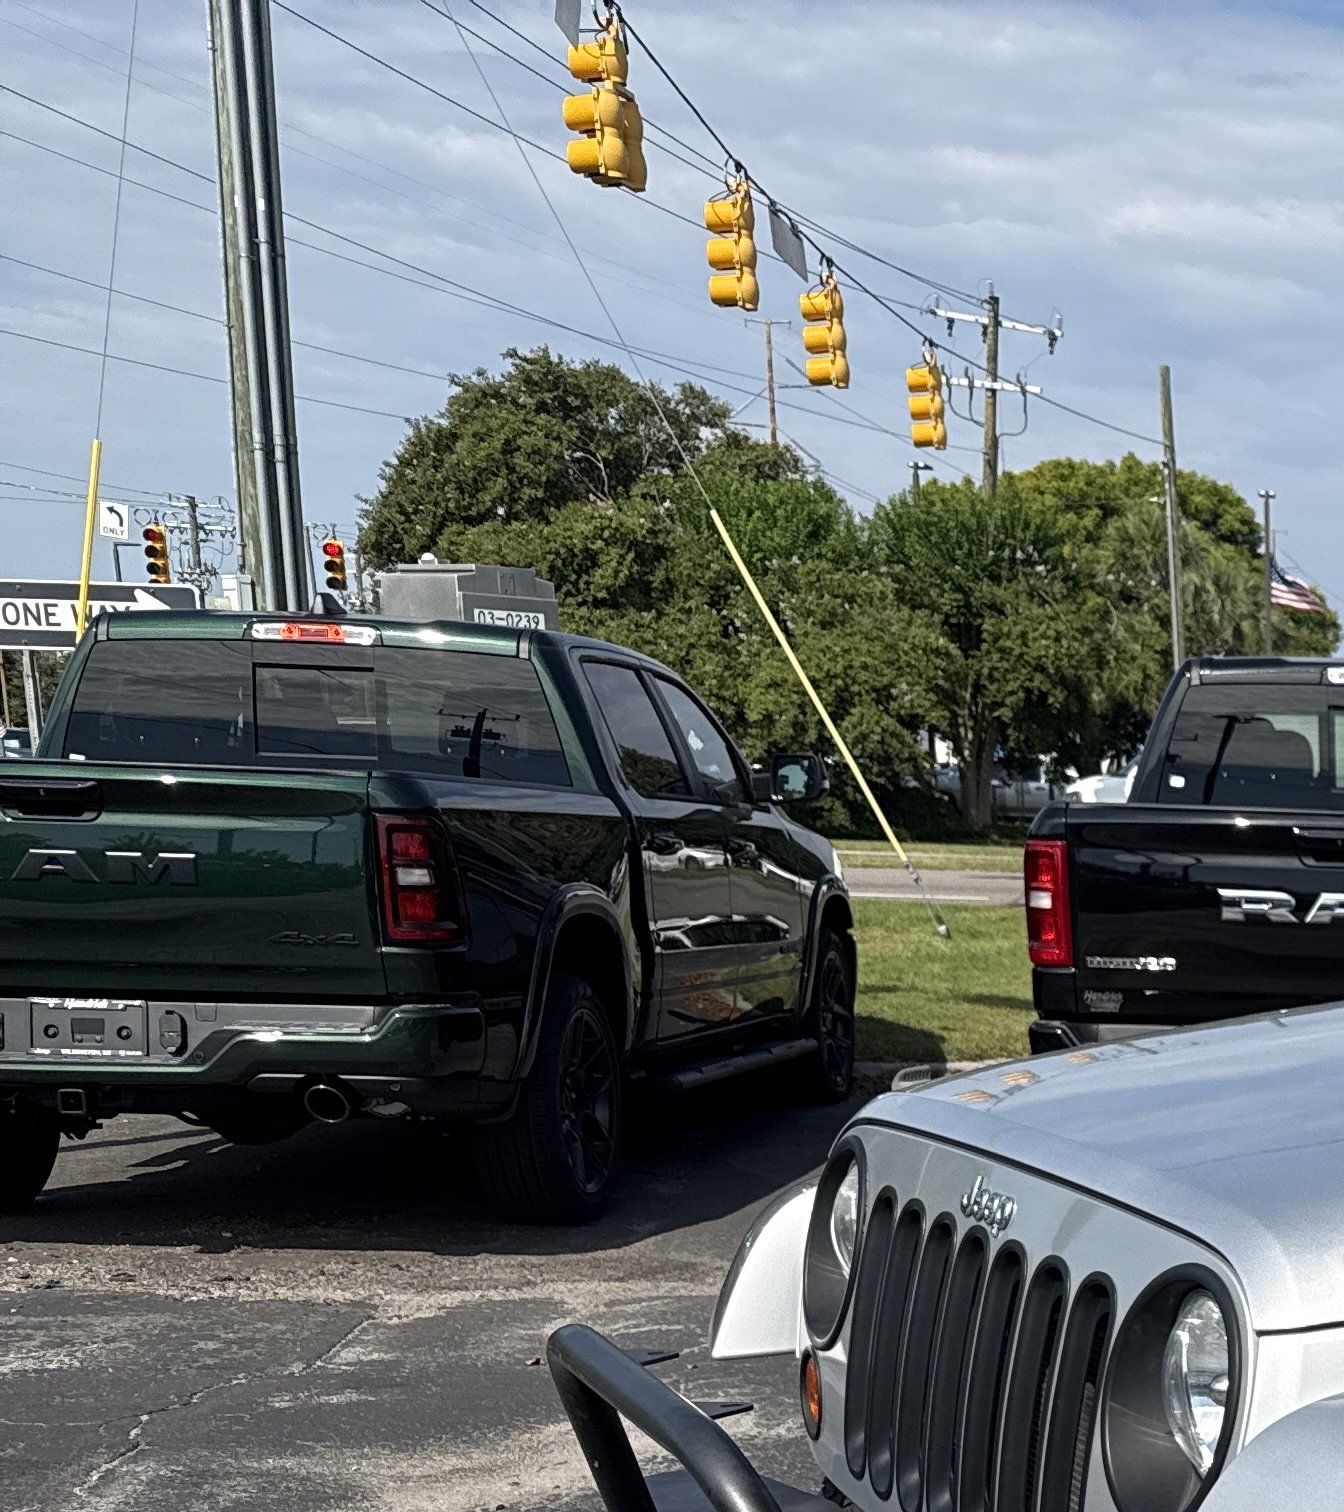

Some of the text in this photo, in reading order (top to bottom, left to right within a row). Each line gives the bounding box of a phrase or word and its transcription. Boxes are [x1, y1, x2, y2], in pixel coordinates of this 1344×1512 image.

[102, 526, 125, 537] ONLY
[2, 602, 62, 627] ONE
[477, 610, 540, 629] 03-0239
[0, 848, 199, 886] AM
[961, 1175, 1016, 1238] Jeep
